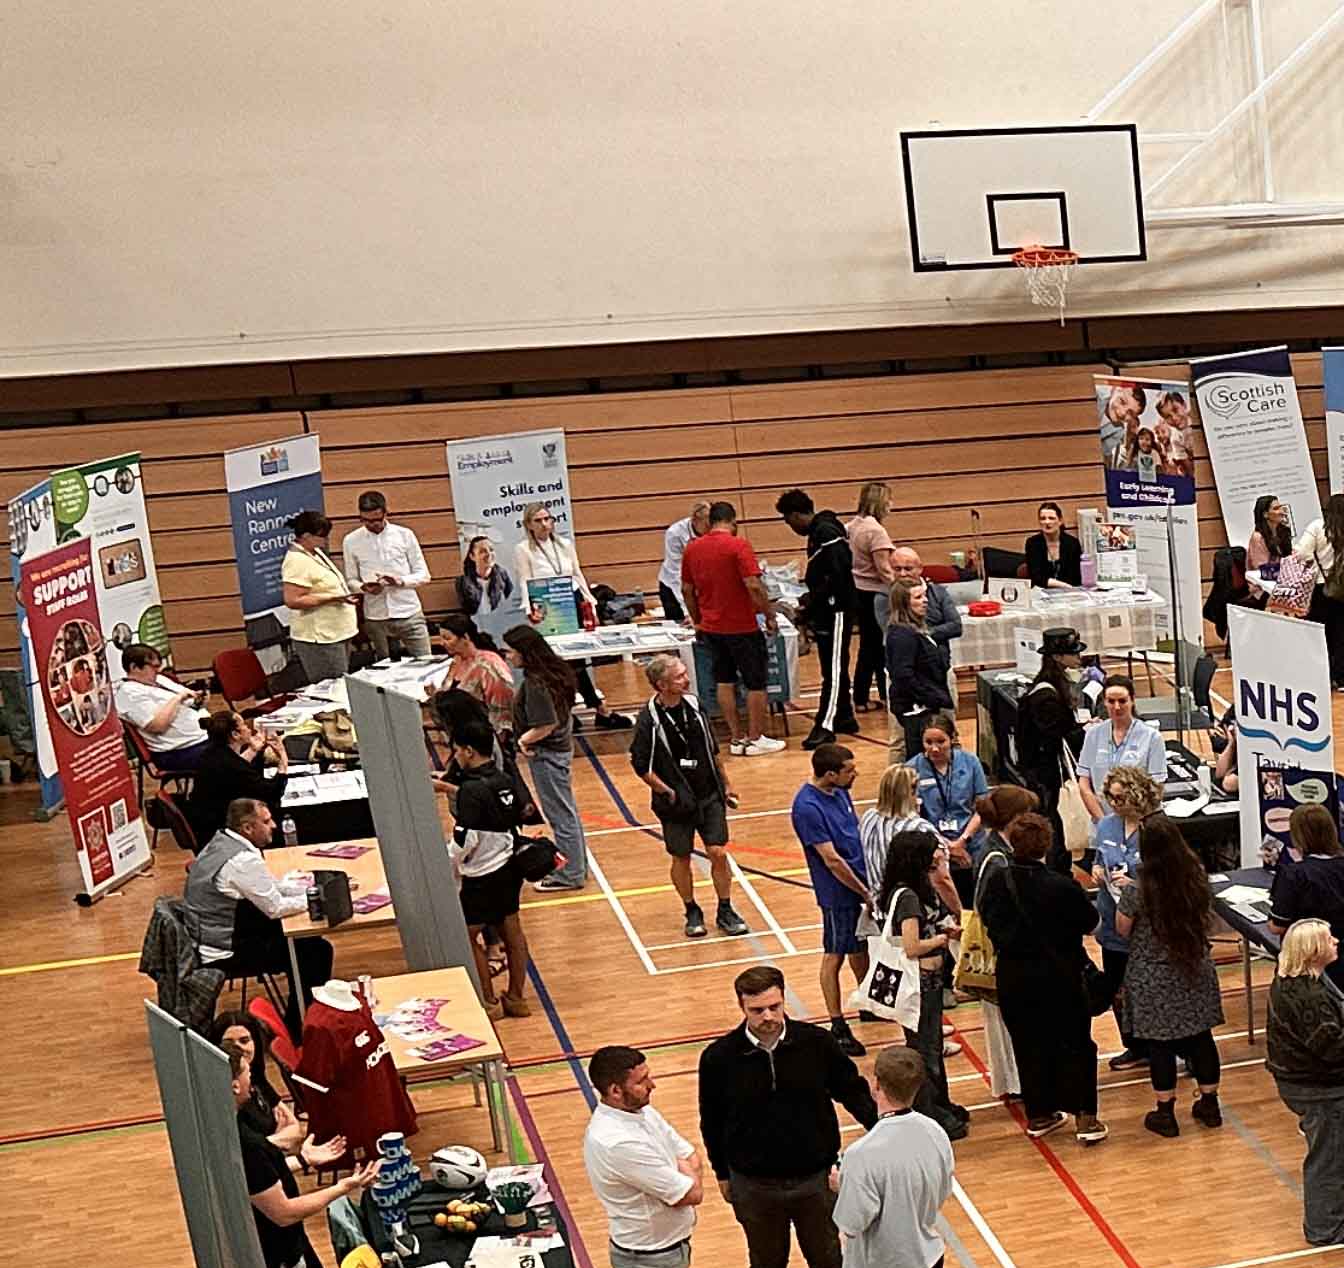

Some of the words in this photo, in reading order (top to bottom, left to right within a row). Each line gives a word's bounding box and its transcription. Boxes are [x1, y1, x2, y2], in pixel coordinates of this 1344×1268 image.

[1217, 383, 1285, 404] Scottish
[1247, 398, 1287, 413] Care
[499, 483, 534, 499] Skills
[537, 477, 564, 494] and
[245, 497, 278, 517] New
[247, 507, 304, 536] Rann
[250, 532, 297, 555] Centre
[33, 566, 92, 606] SUPPORT
[1239, 679, 1320, 732] NHS
